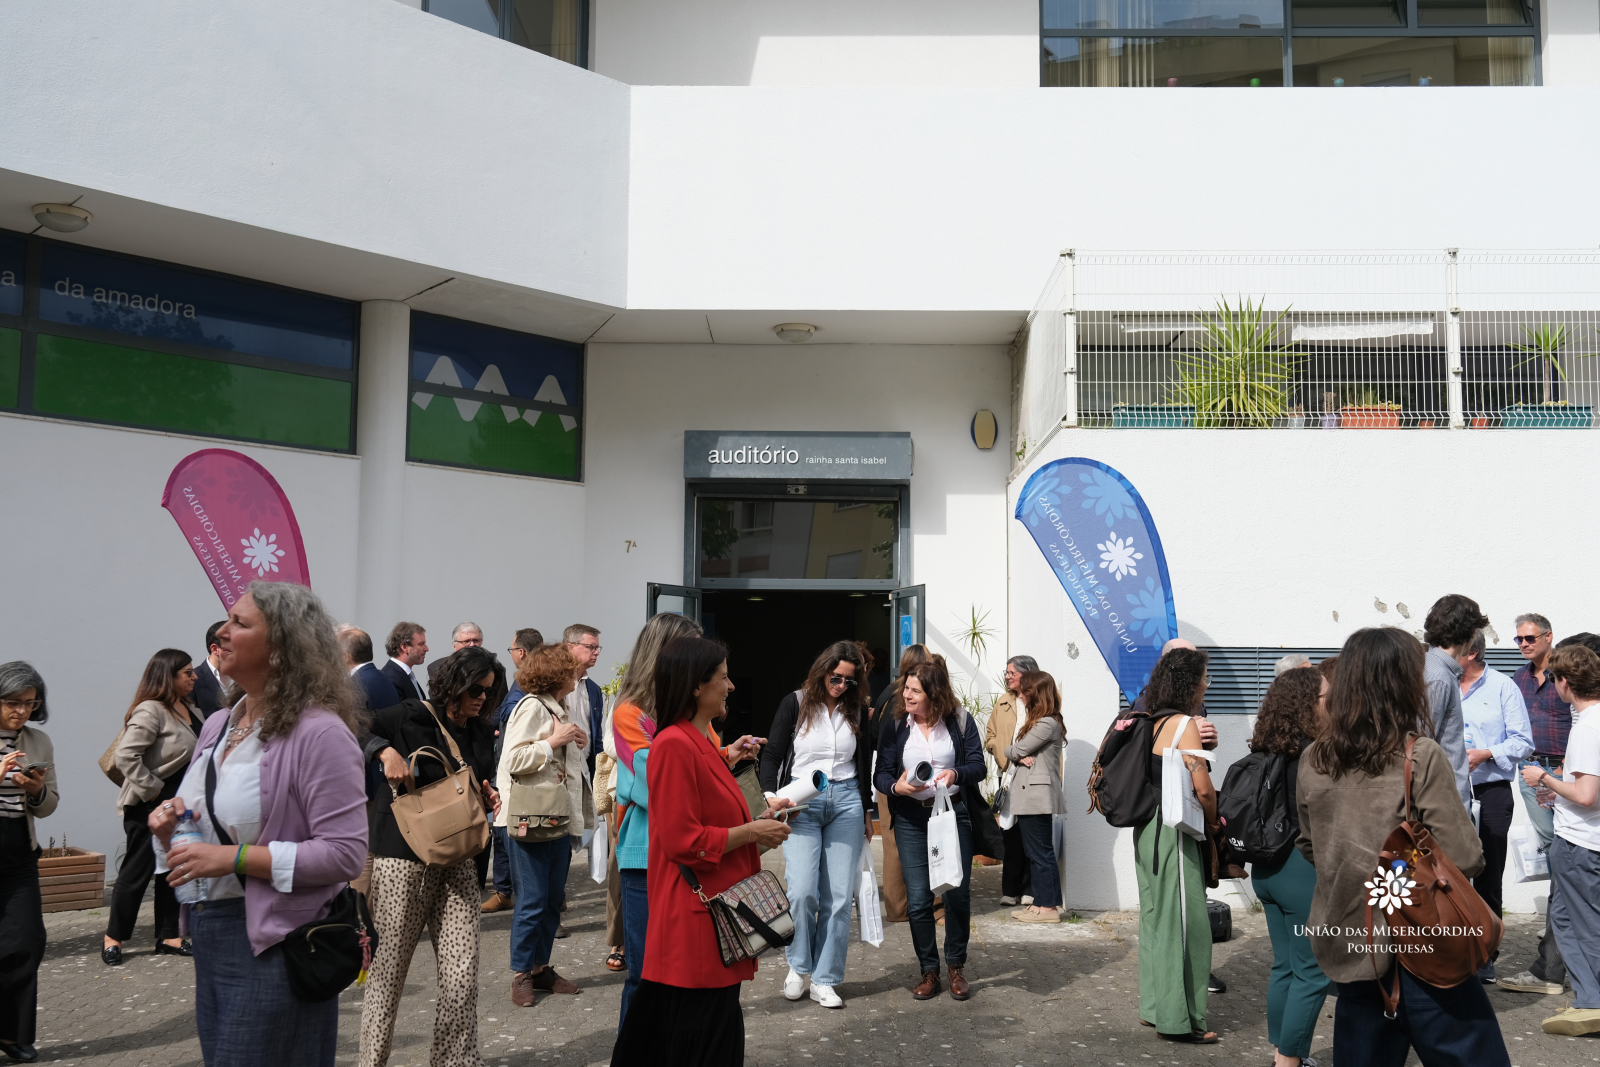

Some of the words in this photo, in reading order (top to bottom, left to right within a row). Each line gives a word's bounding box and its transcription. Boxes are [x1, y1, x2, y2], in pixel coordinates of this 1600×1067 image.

[55, 277, 85, 299] da
[93, 286, 196, 319] amadora
[708, 445, 799, 465] auditório
[805, 456, 833, 464] rainha
[861, 456, 887, 465] isabel
